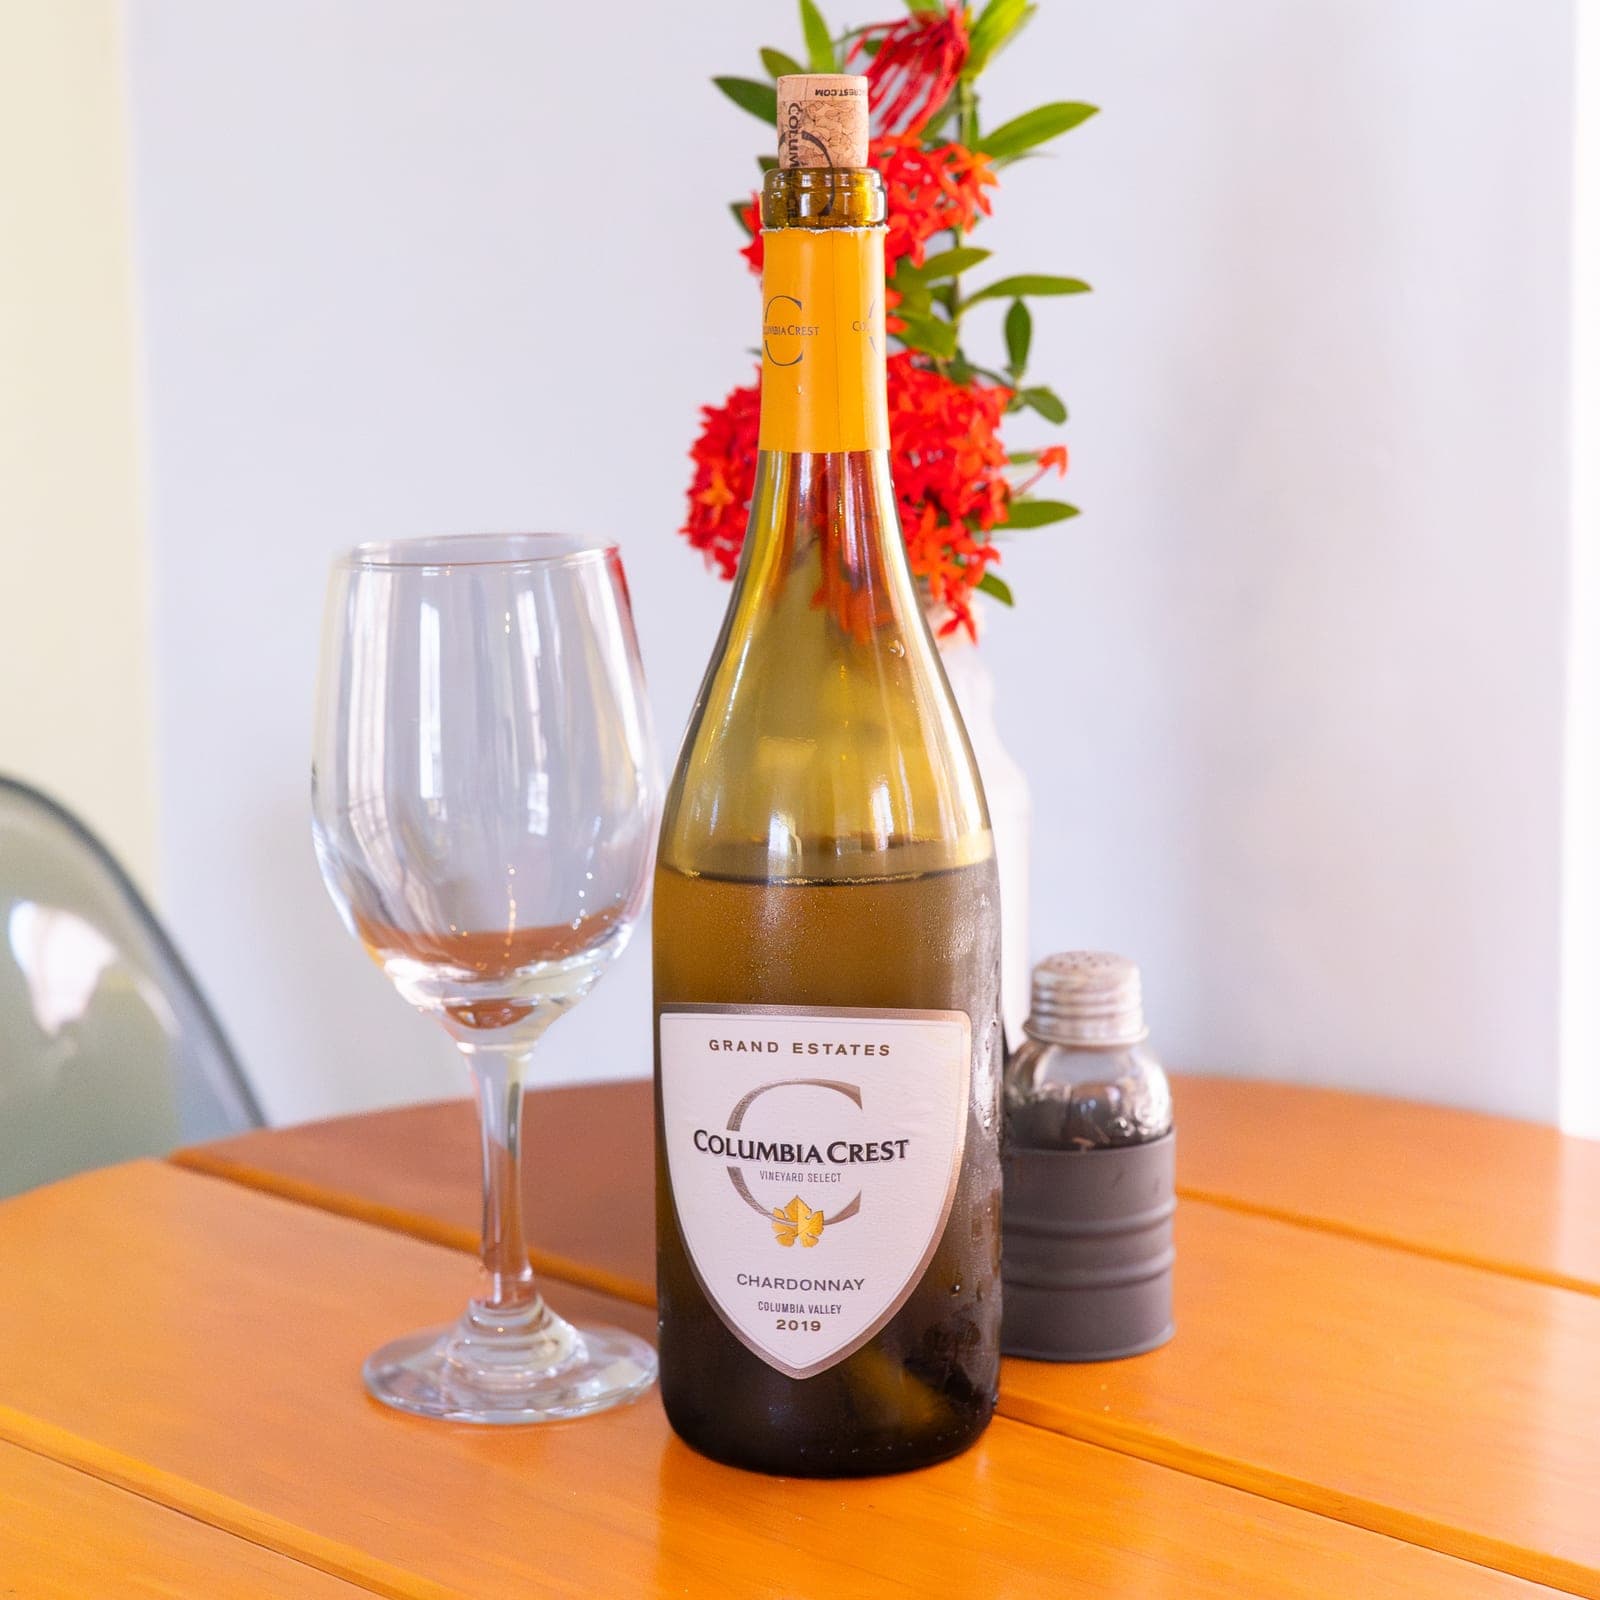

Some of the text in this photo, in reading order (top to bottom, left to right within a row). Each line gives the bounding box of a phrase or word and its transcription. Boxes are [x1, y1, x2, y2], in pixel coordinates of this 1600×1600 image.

[787, 325, 820, 336] CREST
[709, 1039, 891, 1056] GRAND ESTATES
[693, 1129, 910, 1164] COLUMBIA CREST
[759, 1170, 842, 1183] VINEYARD SELECT
[737, 1273, 865, 1291] CHARDONNAY
[758, 1301, 842, 1314] COLUMBIA VALLEY
[776, 1319, 821, 1331] 2019
